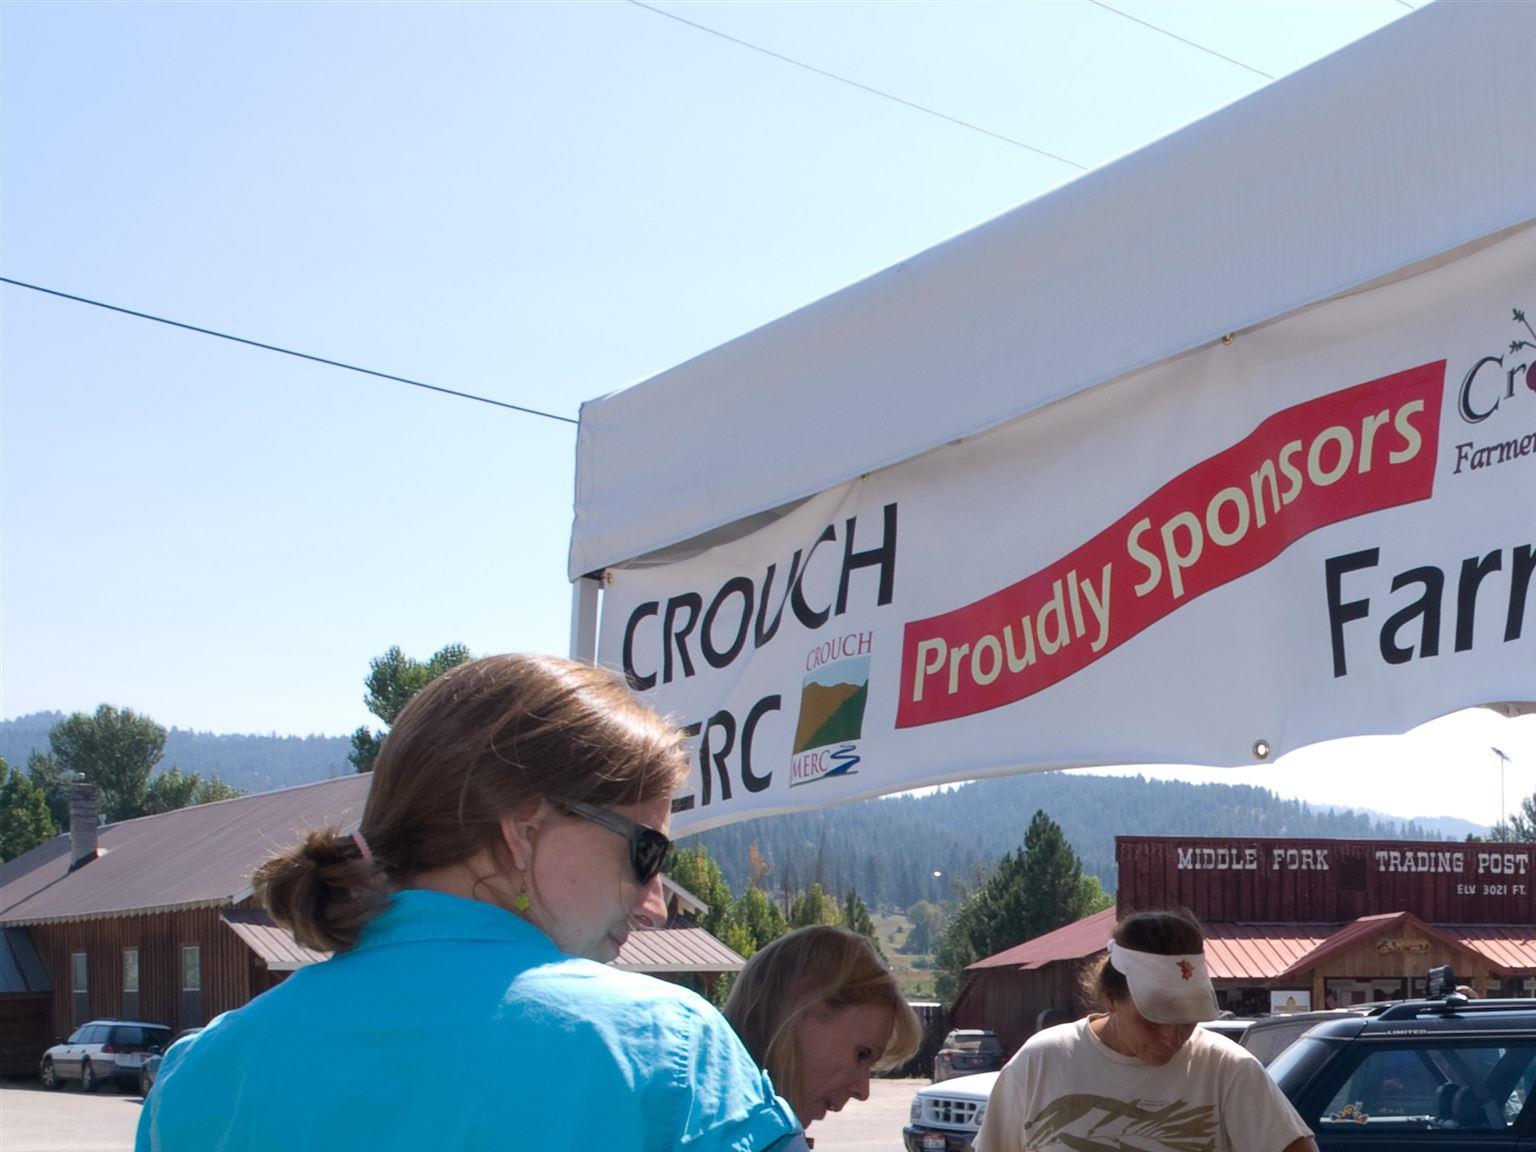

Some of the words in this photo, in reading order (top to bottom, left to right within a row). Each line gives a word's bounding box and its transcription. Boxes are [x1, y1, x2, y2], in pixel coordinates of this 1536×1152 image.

[912, 563, 1112, 703] Proudly
[1126, 398, 1425, 600] Sponsors
[622, 502, 898, 692] CROUCH
[805, 631, 873, 672] CROUCH
[792, 749, 831, 779] MERC
[1177, 847, 1258, 870] MIDDLE
[1272, 849, 1330, 871] FORK
[1375, 850, 1465, 874] TRADING
[1477, 853, 1529, 875] POST
[1483, 885, 1508, 896] 3021
